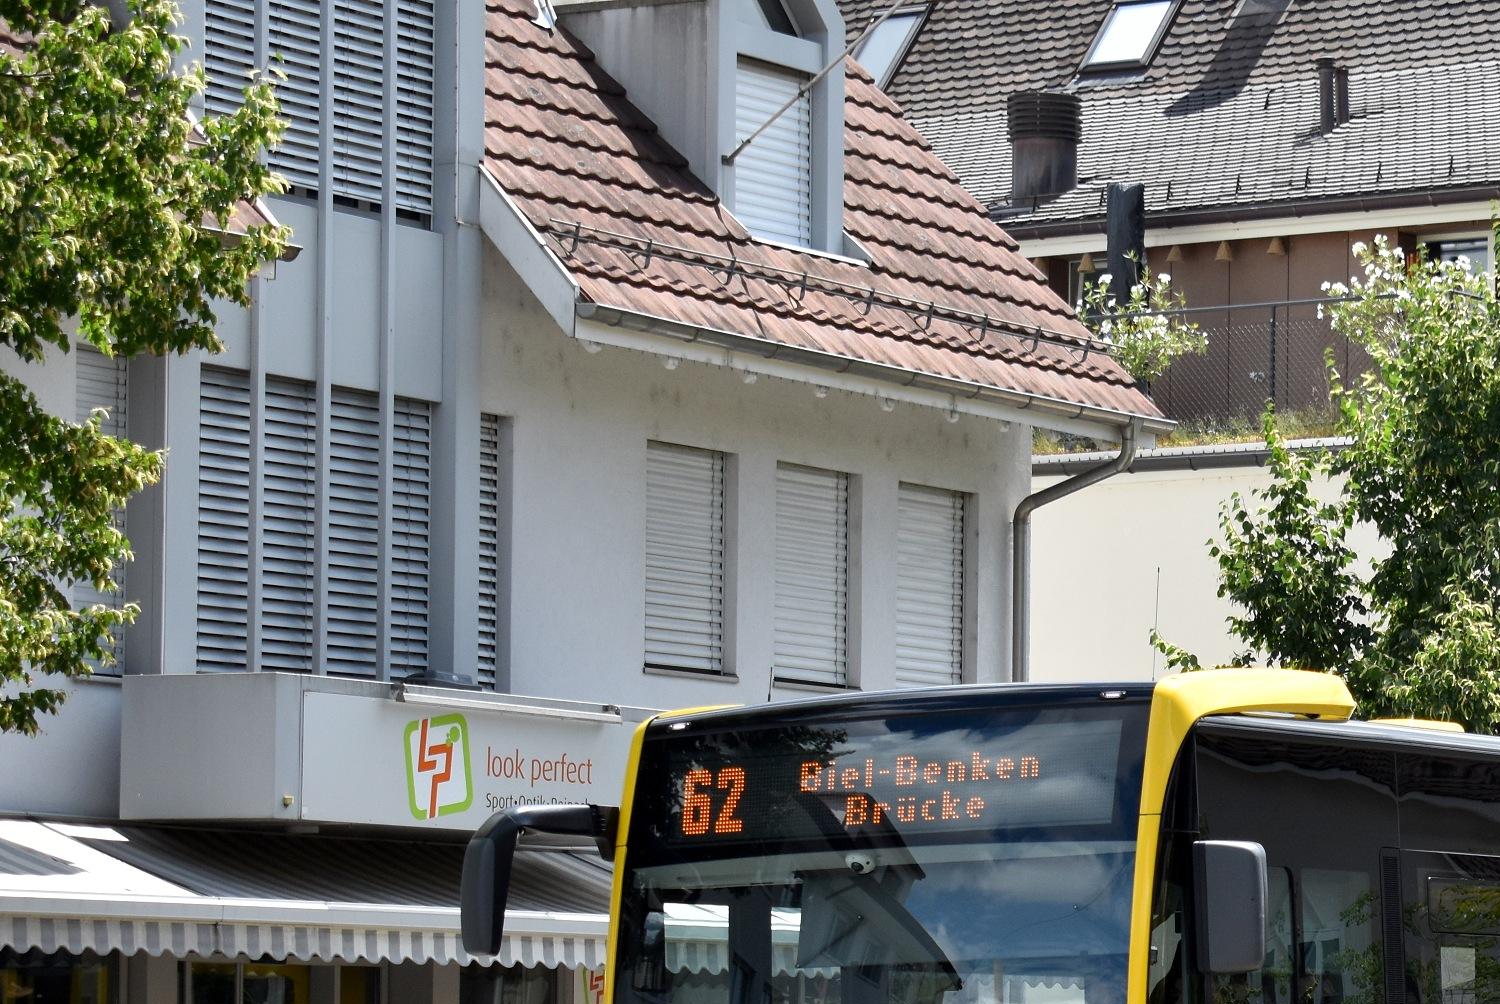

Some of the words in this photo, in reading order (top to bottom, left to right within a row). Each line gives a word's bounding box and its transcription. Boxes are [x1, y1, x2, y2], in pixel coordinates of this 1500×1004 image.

[486, 746, 525, 780] look
[530, 753, 592, 788] perfect
[799, 751, 1040, 793] Biel-Benken
[681, 767, 746, 836] 62
[844, 790, 987, 826] Brücke
